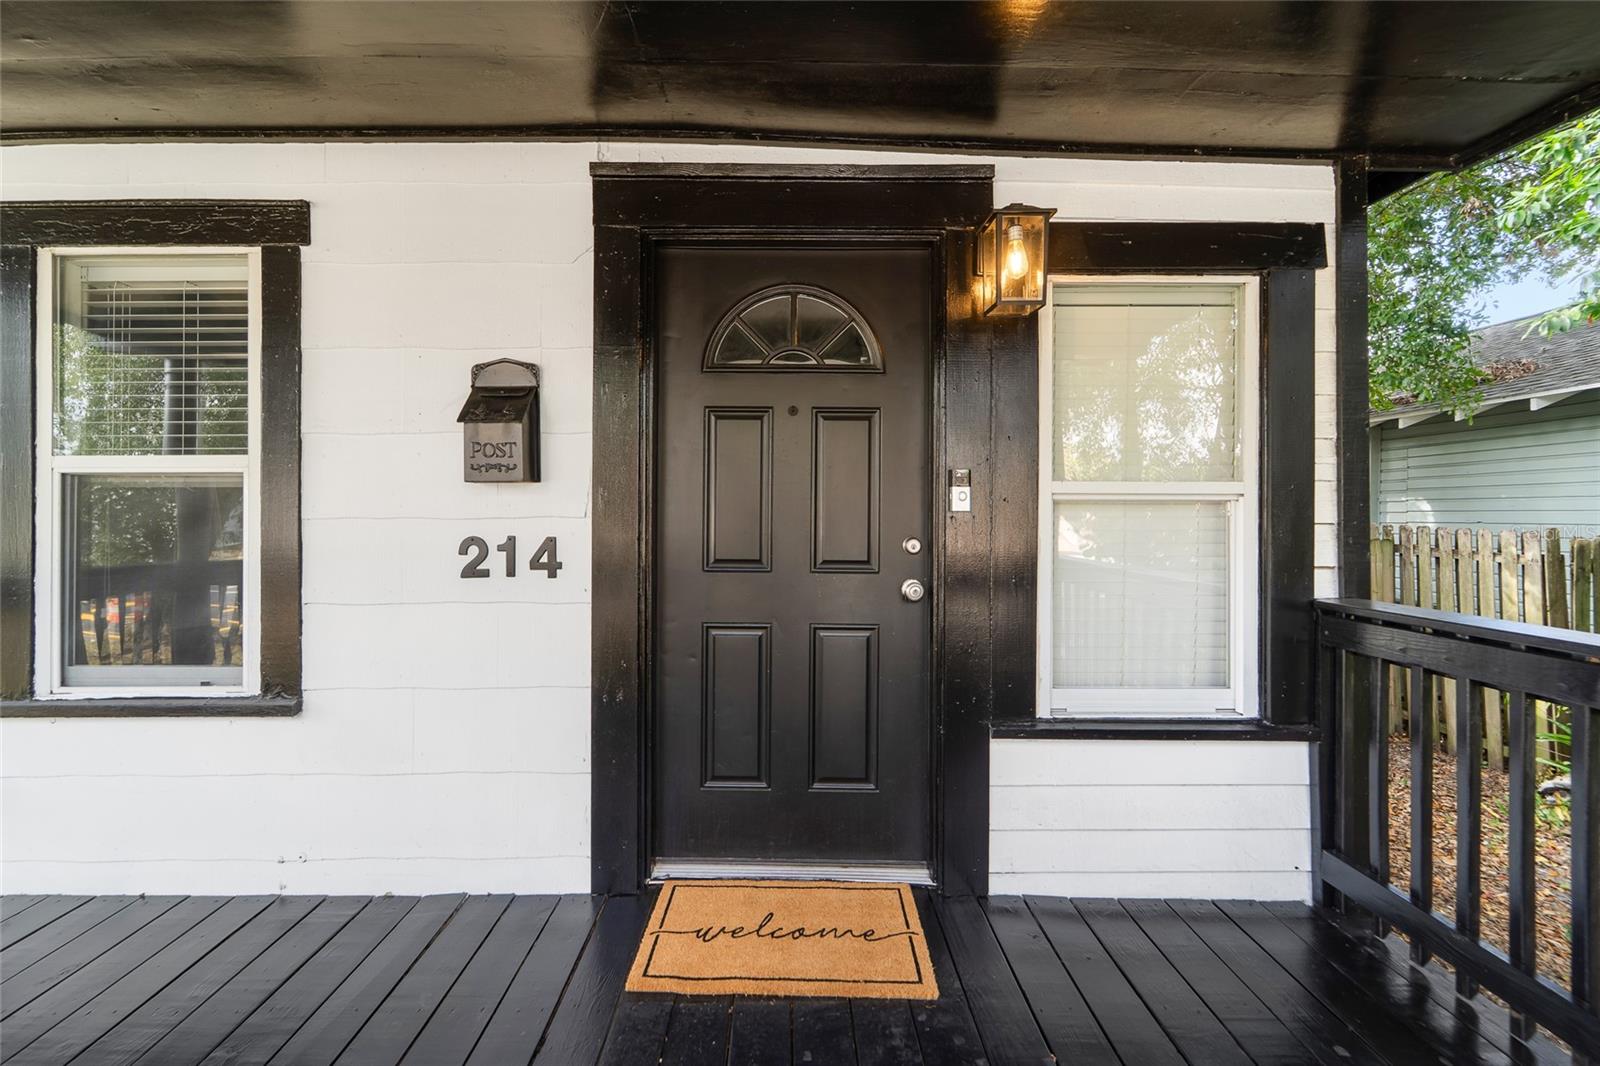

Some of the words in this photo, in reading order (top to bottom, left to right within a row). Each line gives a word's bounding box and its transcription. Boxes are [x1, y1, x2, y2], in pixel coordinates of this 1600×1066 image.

[470, 441, 517, 458] POST
[458, 535, 562, 578] 214
[688, 912, 894, 943] welcome
